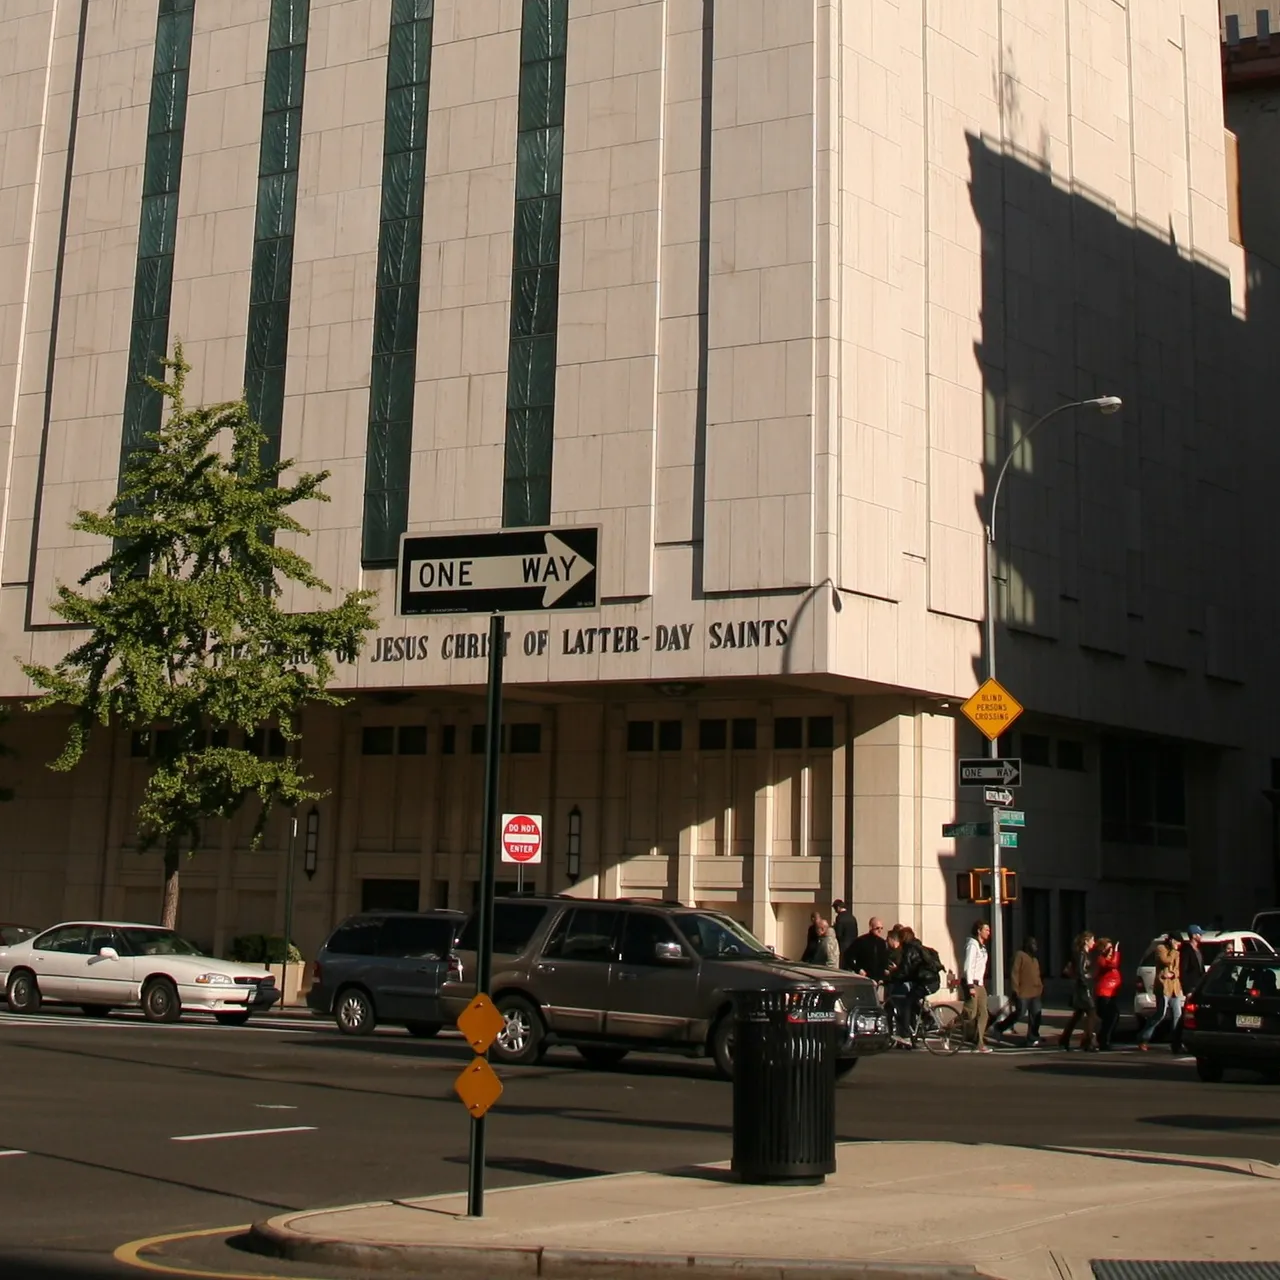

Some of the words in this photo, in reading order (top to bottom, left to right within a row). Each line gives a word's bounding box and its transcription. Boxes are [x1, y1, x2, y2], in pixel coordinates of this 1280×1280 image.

[419, 561, 473, 588] ONE
[522, 555, 577, 583] WAY
[371, 635, 429, 663] JESUS
[523, 630, 548, 656] OF
[562, 623, 694, 655] LATTER-DAY
[709, 619, 788, 649] SAINTS
[964, 769, 982, 777] ONE
[996, 768, 1014, 777] WAY
[509, 824, 518, 832] DO
